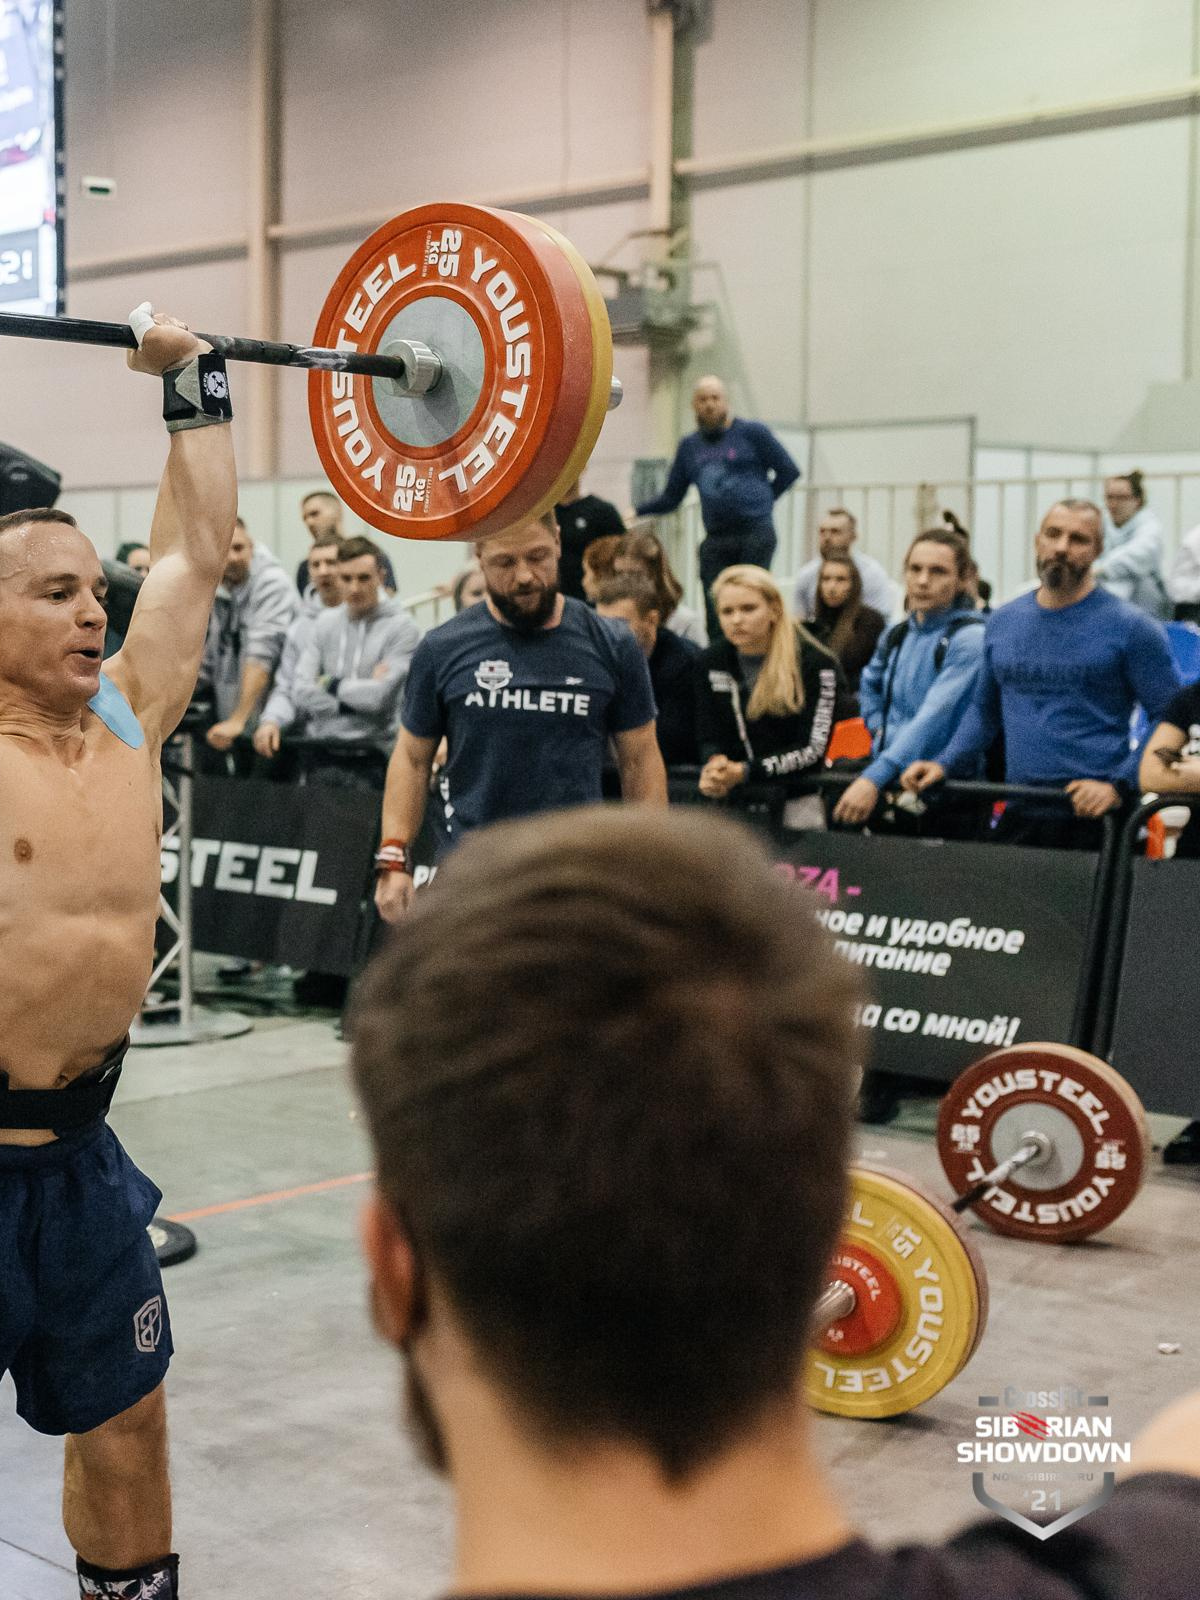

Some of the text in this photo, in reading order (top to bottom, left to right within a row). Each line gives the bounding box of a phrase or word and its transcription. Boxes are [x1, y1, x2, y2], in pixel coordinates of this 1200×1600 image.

[428, 241, 441, 265] KG
[438, 229, 463, 277] 25
[331, 253, 417, 492] YOUSTEEL
[439, 246, 532, 494] YOUSTEEL
[392, 464, 417, 513] 25
[414, 478, 427, 502] KG
[464, 687, 591, 716] ATHLETE
[864, 913, 889, 939] и
[887, 917, 1026, 955] удобное
[883, 1006, 922, 1033] со
[921, 1013, 1022, 1049] мной!
[960, 1068, 1111, 1136] YOUSTEEL
[965, 1156, 1116, 1225] YOUSTEL
[814, 1256, 944, 1394] YOUSTEEL
